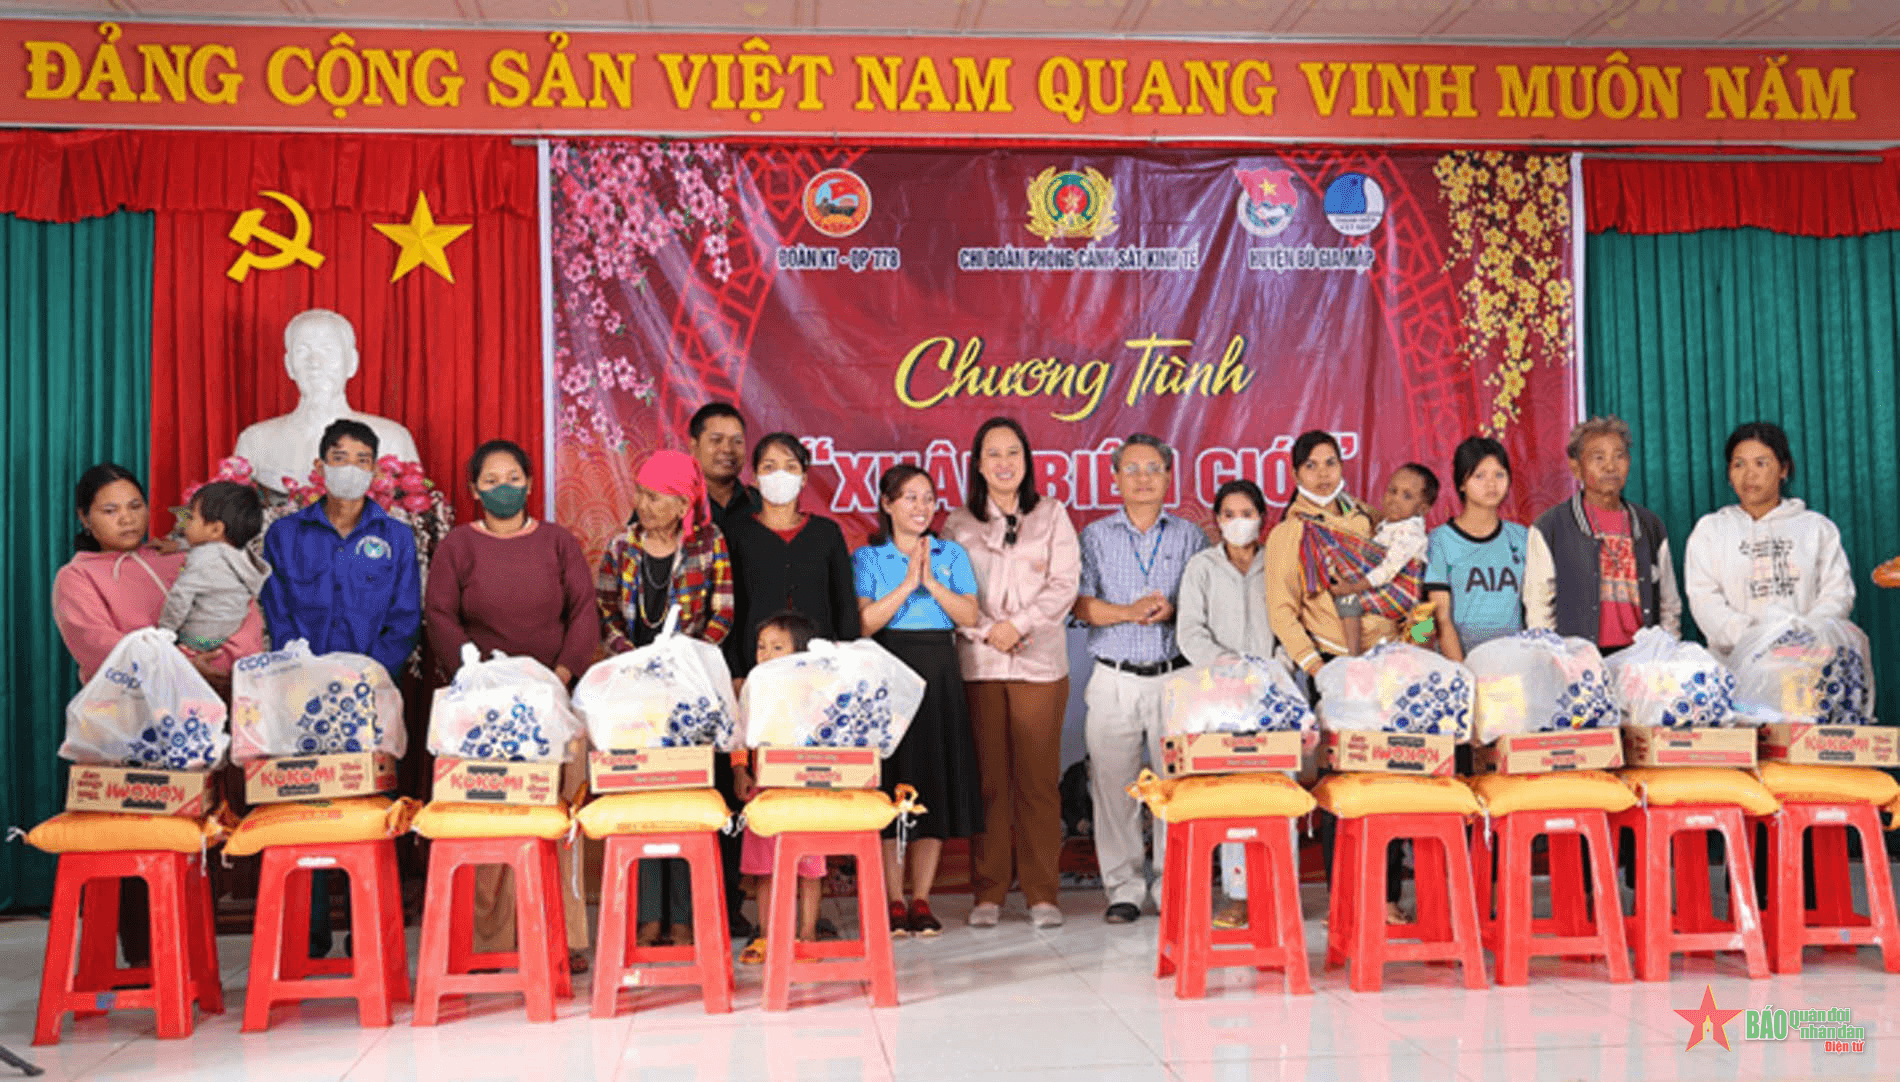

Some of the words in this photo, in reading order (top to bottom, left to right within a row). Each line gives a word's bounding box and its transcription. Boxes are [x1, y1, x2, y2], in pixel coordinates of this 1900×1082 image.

[25, 22, 243, 104] ĐẢNG
[268, 32, 464, 119] CỘNG
[488, 30, 636, 109] SẢN
[658, 36, 834, 123] VIỆT
[855, 55, 1013, 113] NAM
[1038, 56, 1278, 124] QUANG
[1300, 62, 1479, 118] VINH
[1496, 50, 1682, 120] MUÔN
[1704, 54, 1857, 120] NĂM
[777, 243, 817, 269] ĐOÀN
[817, 248, 839, 269] KT
[849, 247, 870, 272] QP
[869, 247, 900, 270] 778
[895, 336, 1112, 422] Chương
[1124, 333, 1258, 408] Trình
[1465, 566, 1518, 593] AIA
[260, 764, 337, 788] KOKOMI
[450, 773, 524, 791] KOKOMI
